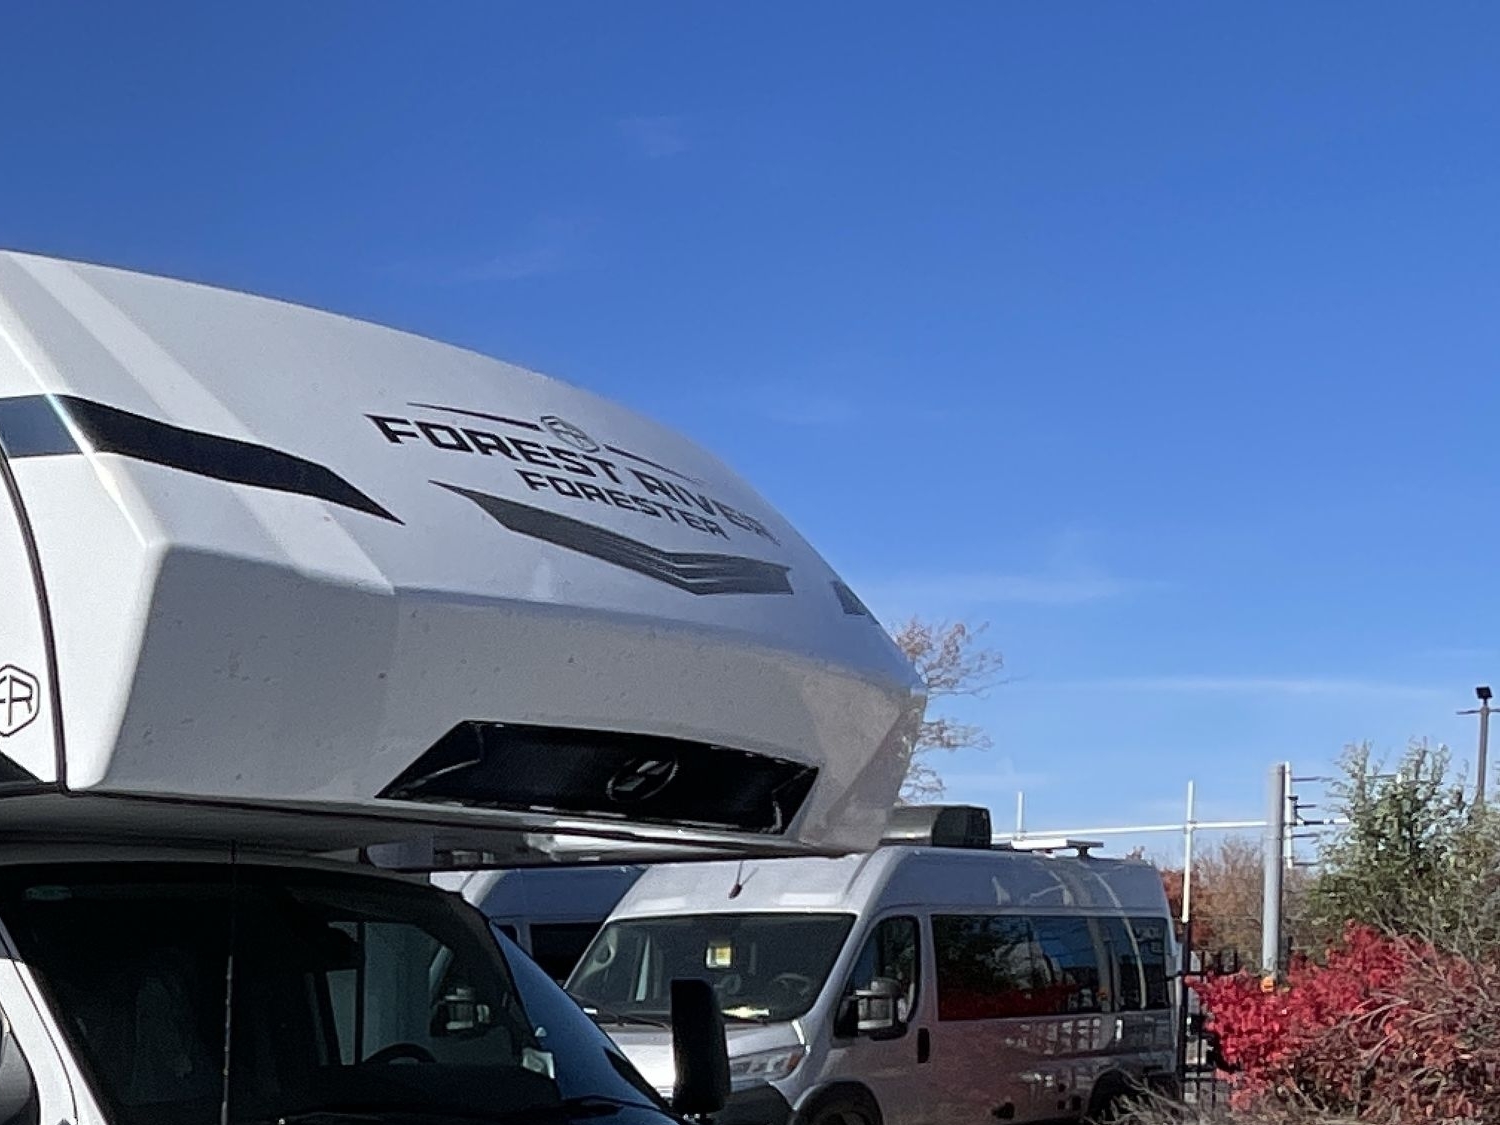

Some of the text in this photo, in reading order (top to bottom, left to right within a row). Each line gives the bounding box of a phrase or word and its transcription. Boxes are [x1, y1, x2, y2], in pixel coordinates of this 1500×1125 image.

[364, 413, 621, 485] FOREST
[625, 467, 781, 547] RIVER
[514, 468, 731, 541] FORESTER
